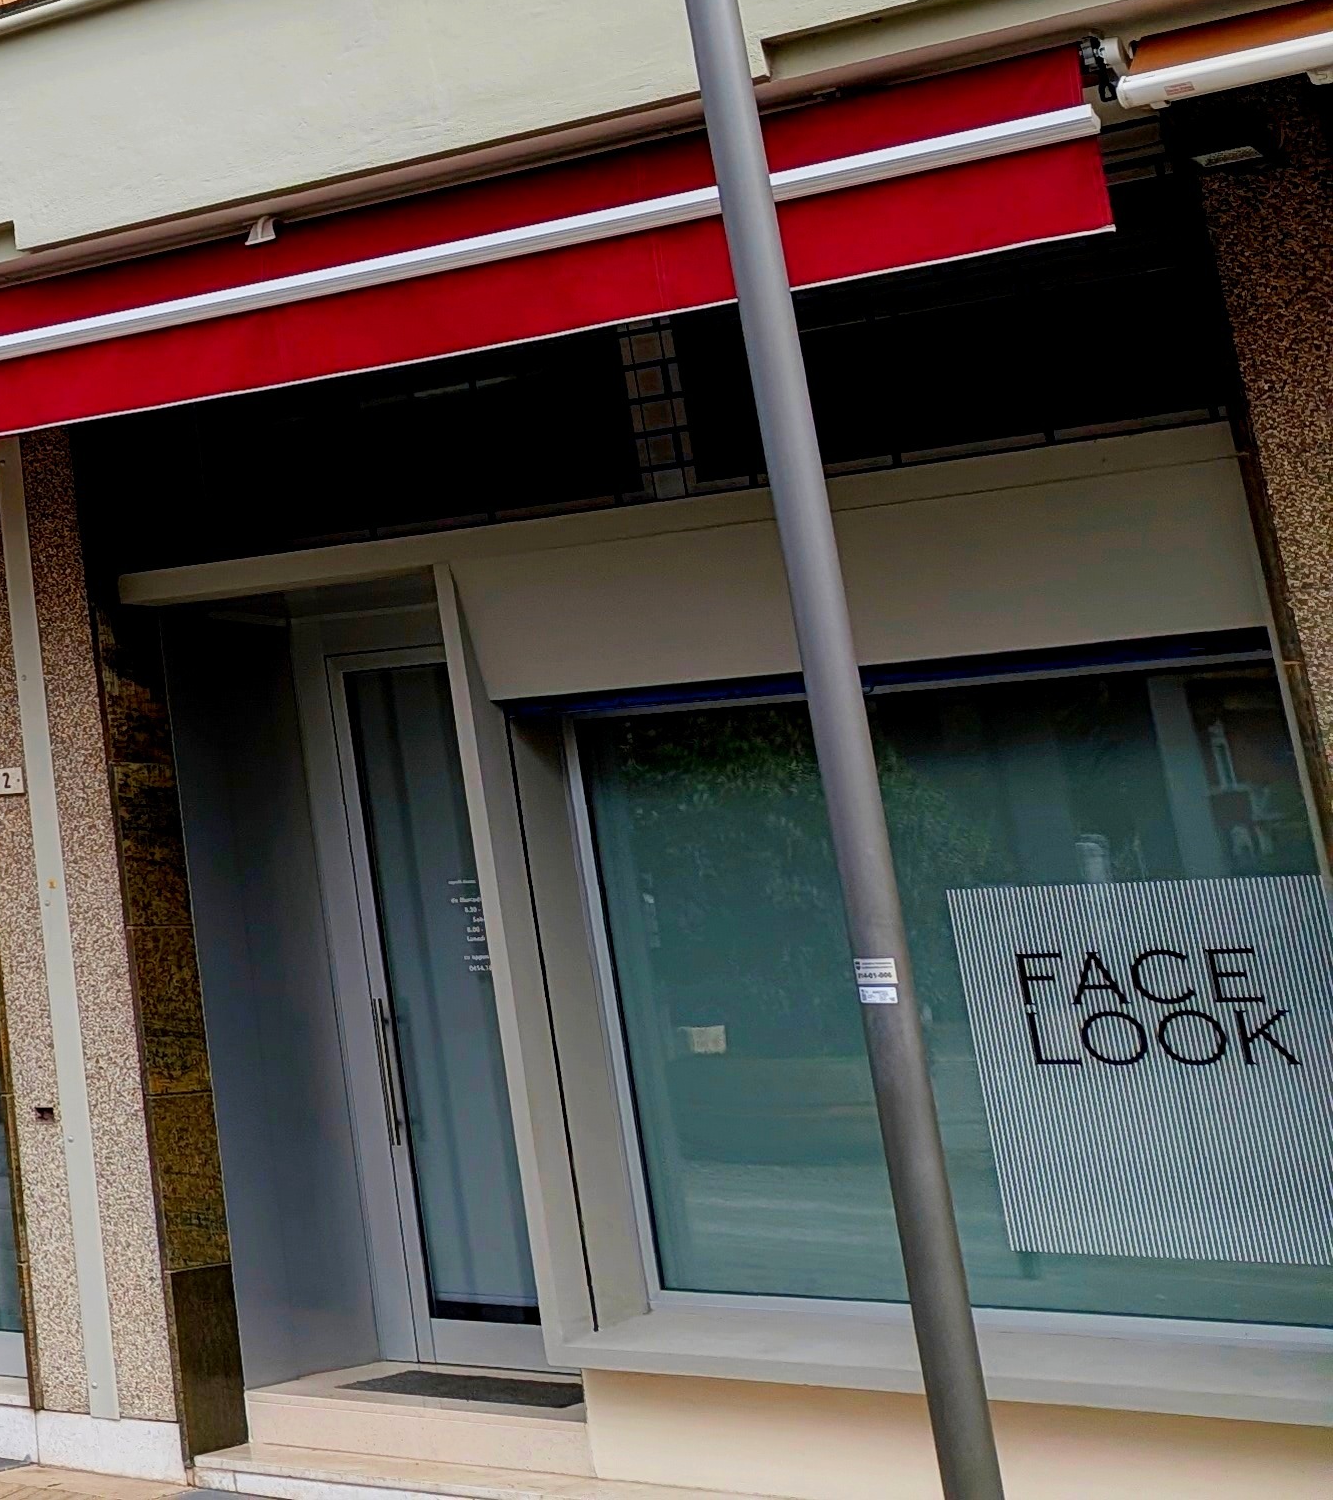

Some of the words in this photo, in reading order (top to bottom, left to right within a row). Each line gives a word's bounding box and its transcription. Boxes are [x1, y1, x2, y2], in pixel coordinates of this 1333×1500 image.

[2, 772, 11, 789] 2
[1015, 947, 1266, 1005] FACE
[1026, 1008, 1303, 1066] LOOK
